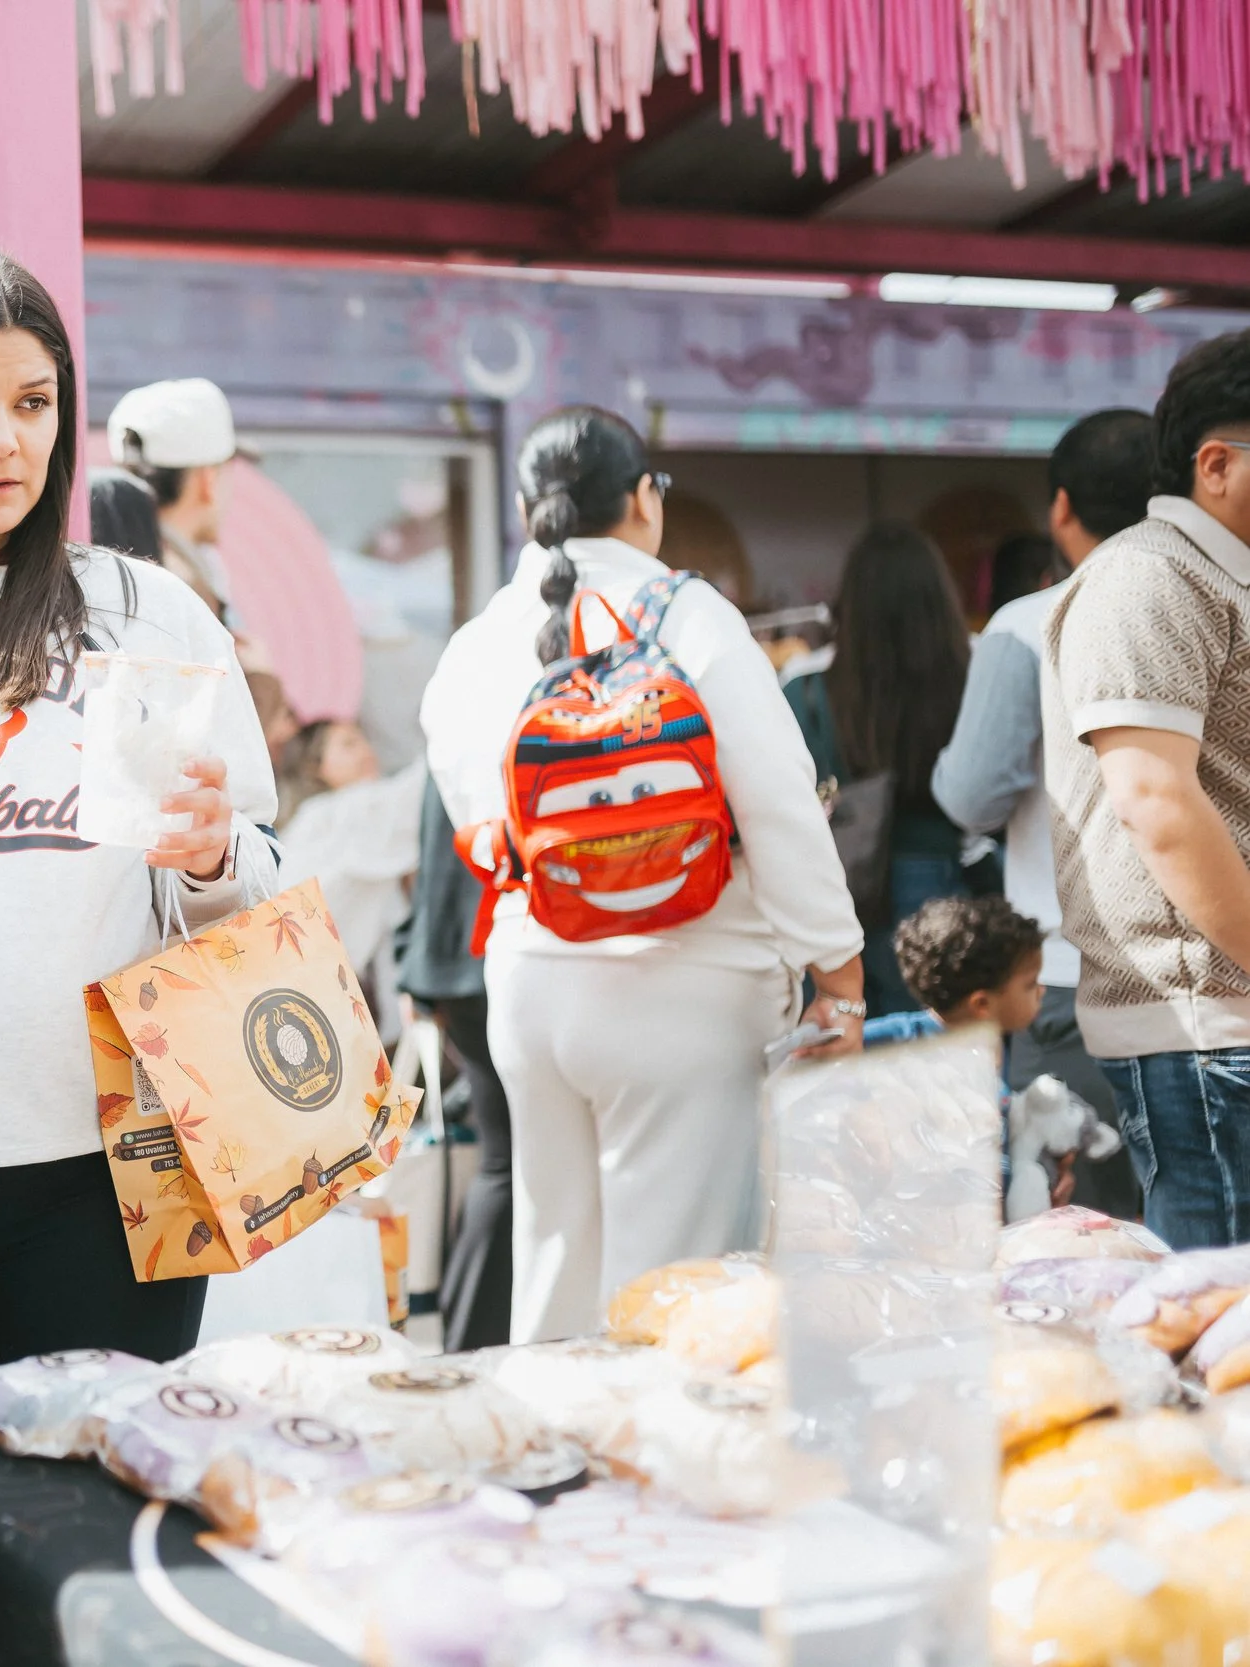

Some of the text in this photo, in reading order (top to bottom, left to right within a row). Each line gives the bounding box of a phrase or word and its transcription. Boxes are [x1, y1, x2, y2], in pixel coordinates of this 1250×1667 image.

[621, 699, 663, 746] 95
[134, 1148, 145, 1157] 180
[145, 1145, 166, 1154] Uvalde
